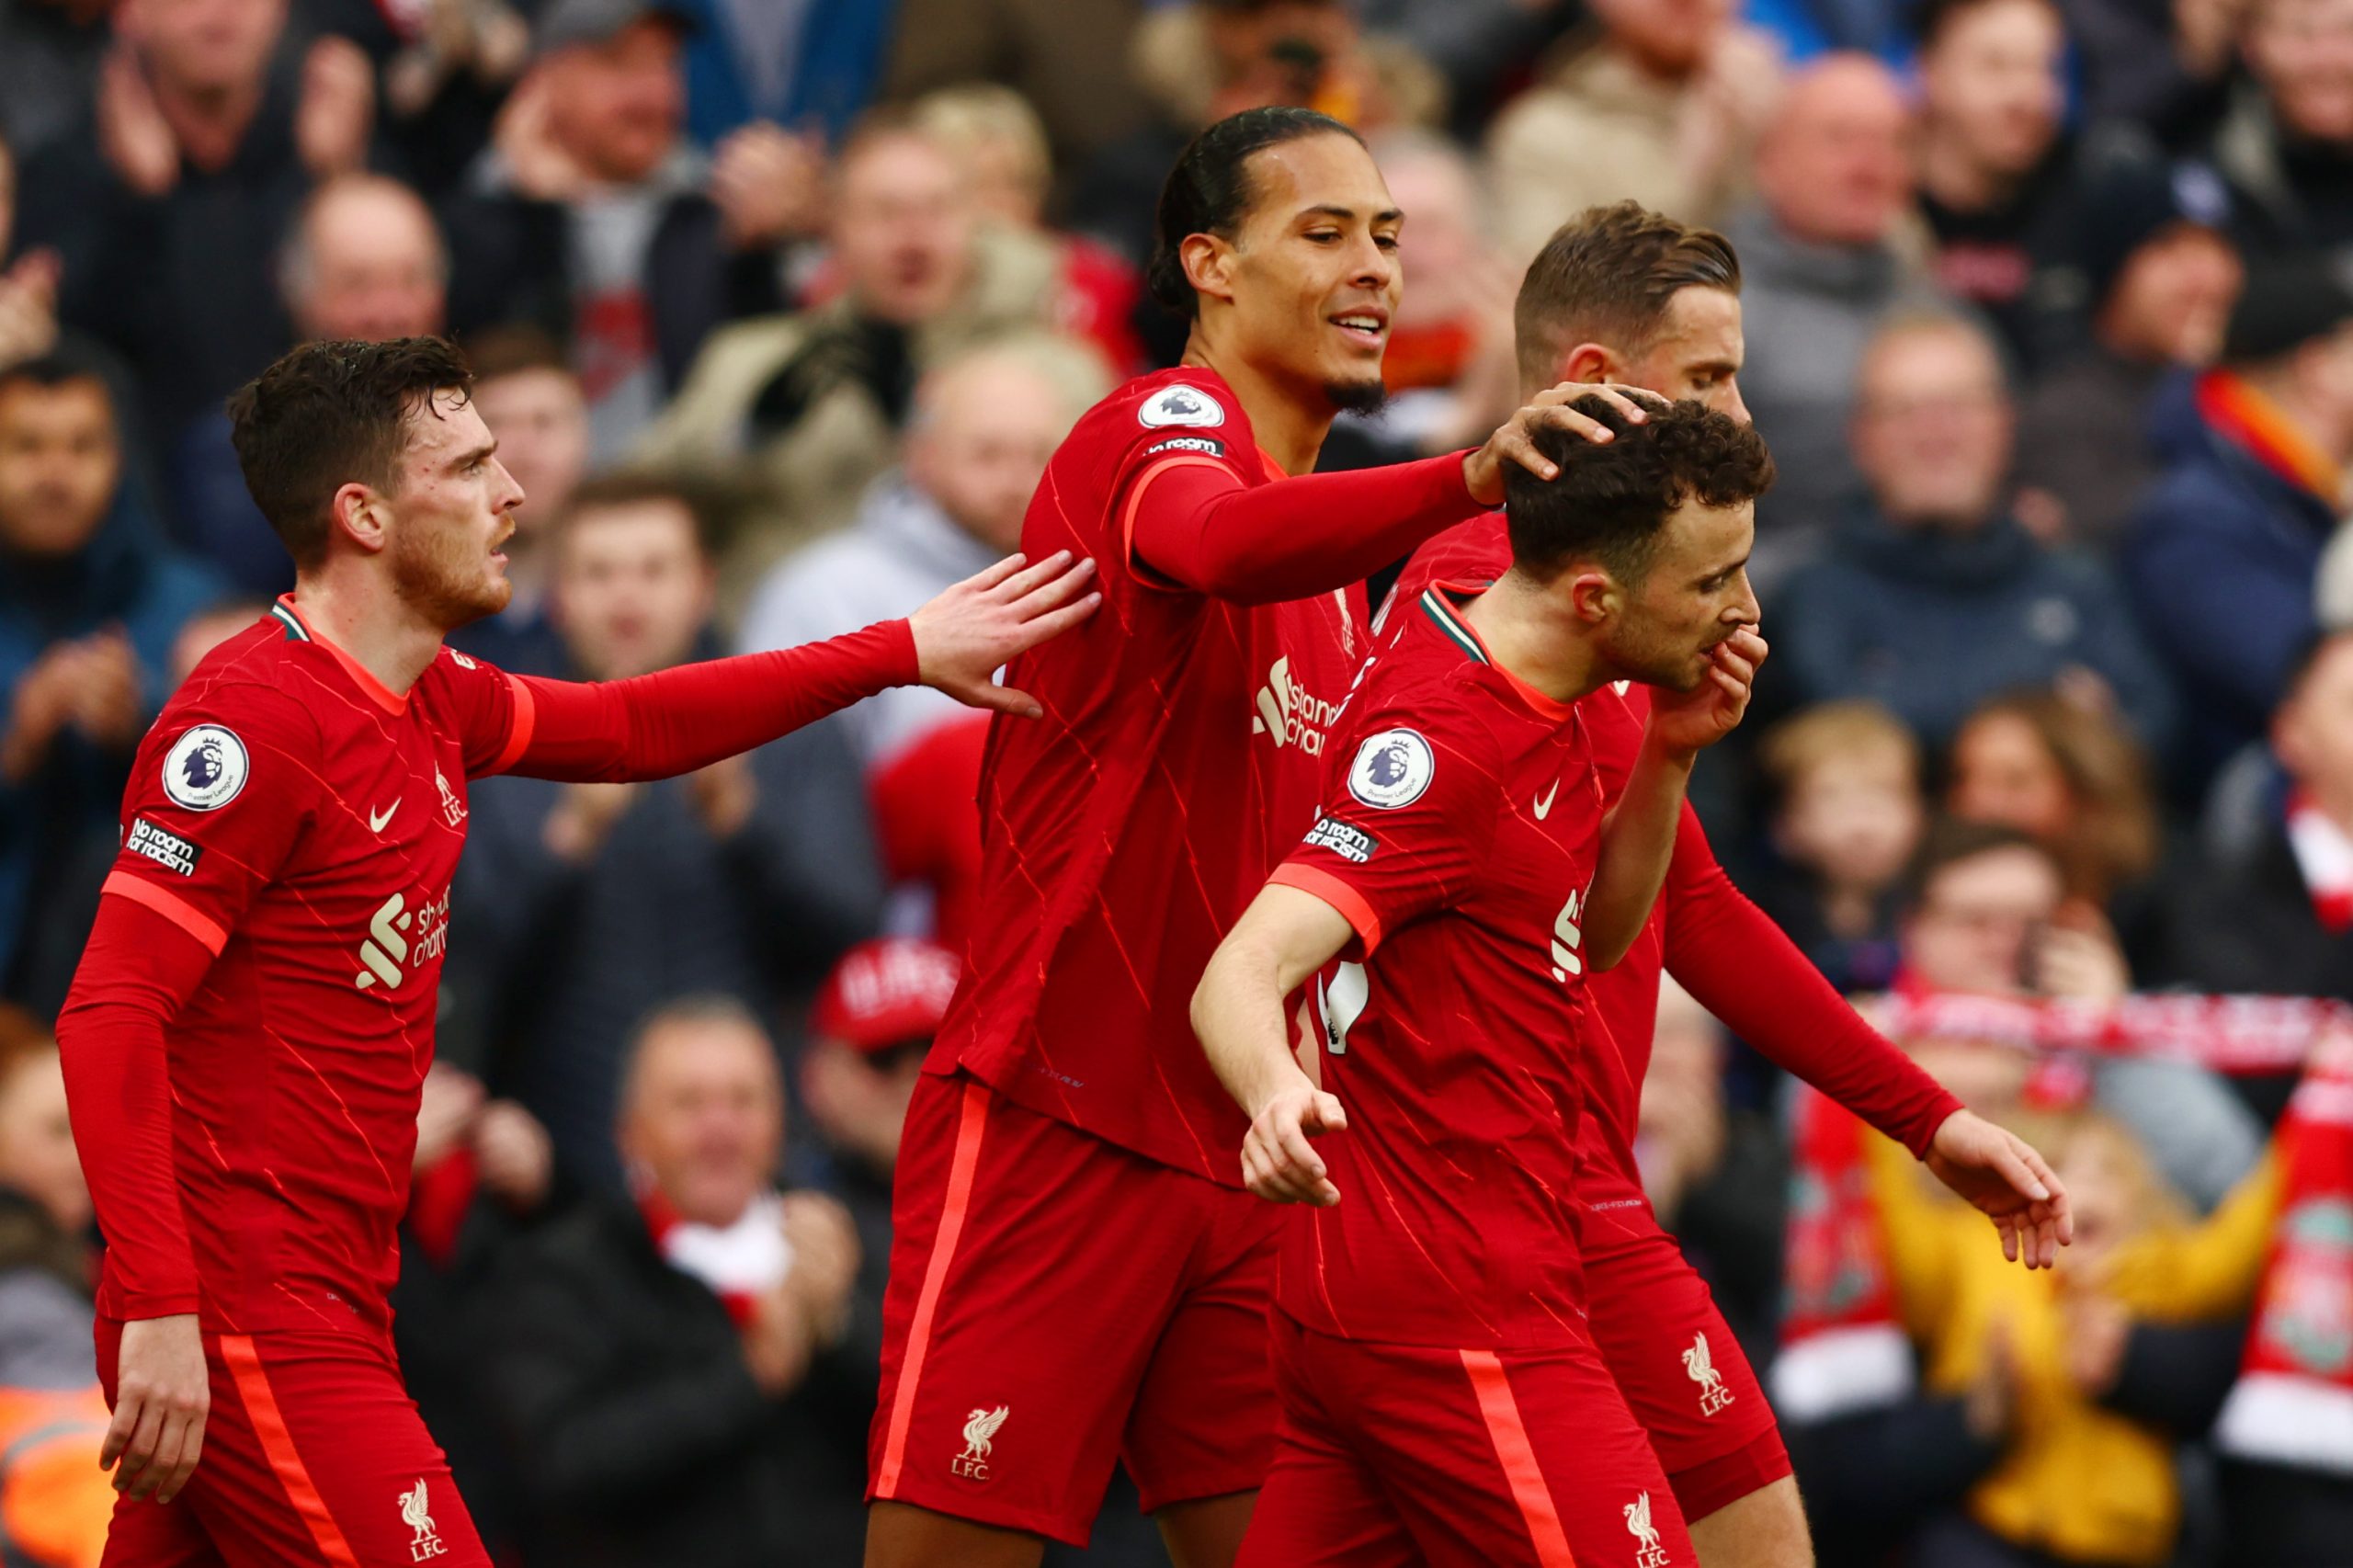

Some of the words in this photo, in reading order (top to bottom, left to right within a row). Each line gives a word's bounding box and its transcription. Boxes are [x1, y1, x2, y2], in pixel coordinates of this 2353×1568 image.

[213, 775, 233, 797] League
[1395, 778, 1416, 797] League
[132, 817, 151, 839] No
[149, 829, 194, 859] room
[1314, 818, 1329, 832] o
[1327, 822, 1369, 850] room
[141, 841, 194, 877] racism
